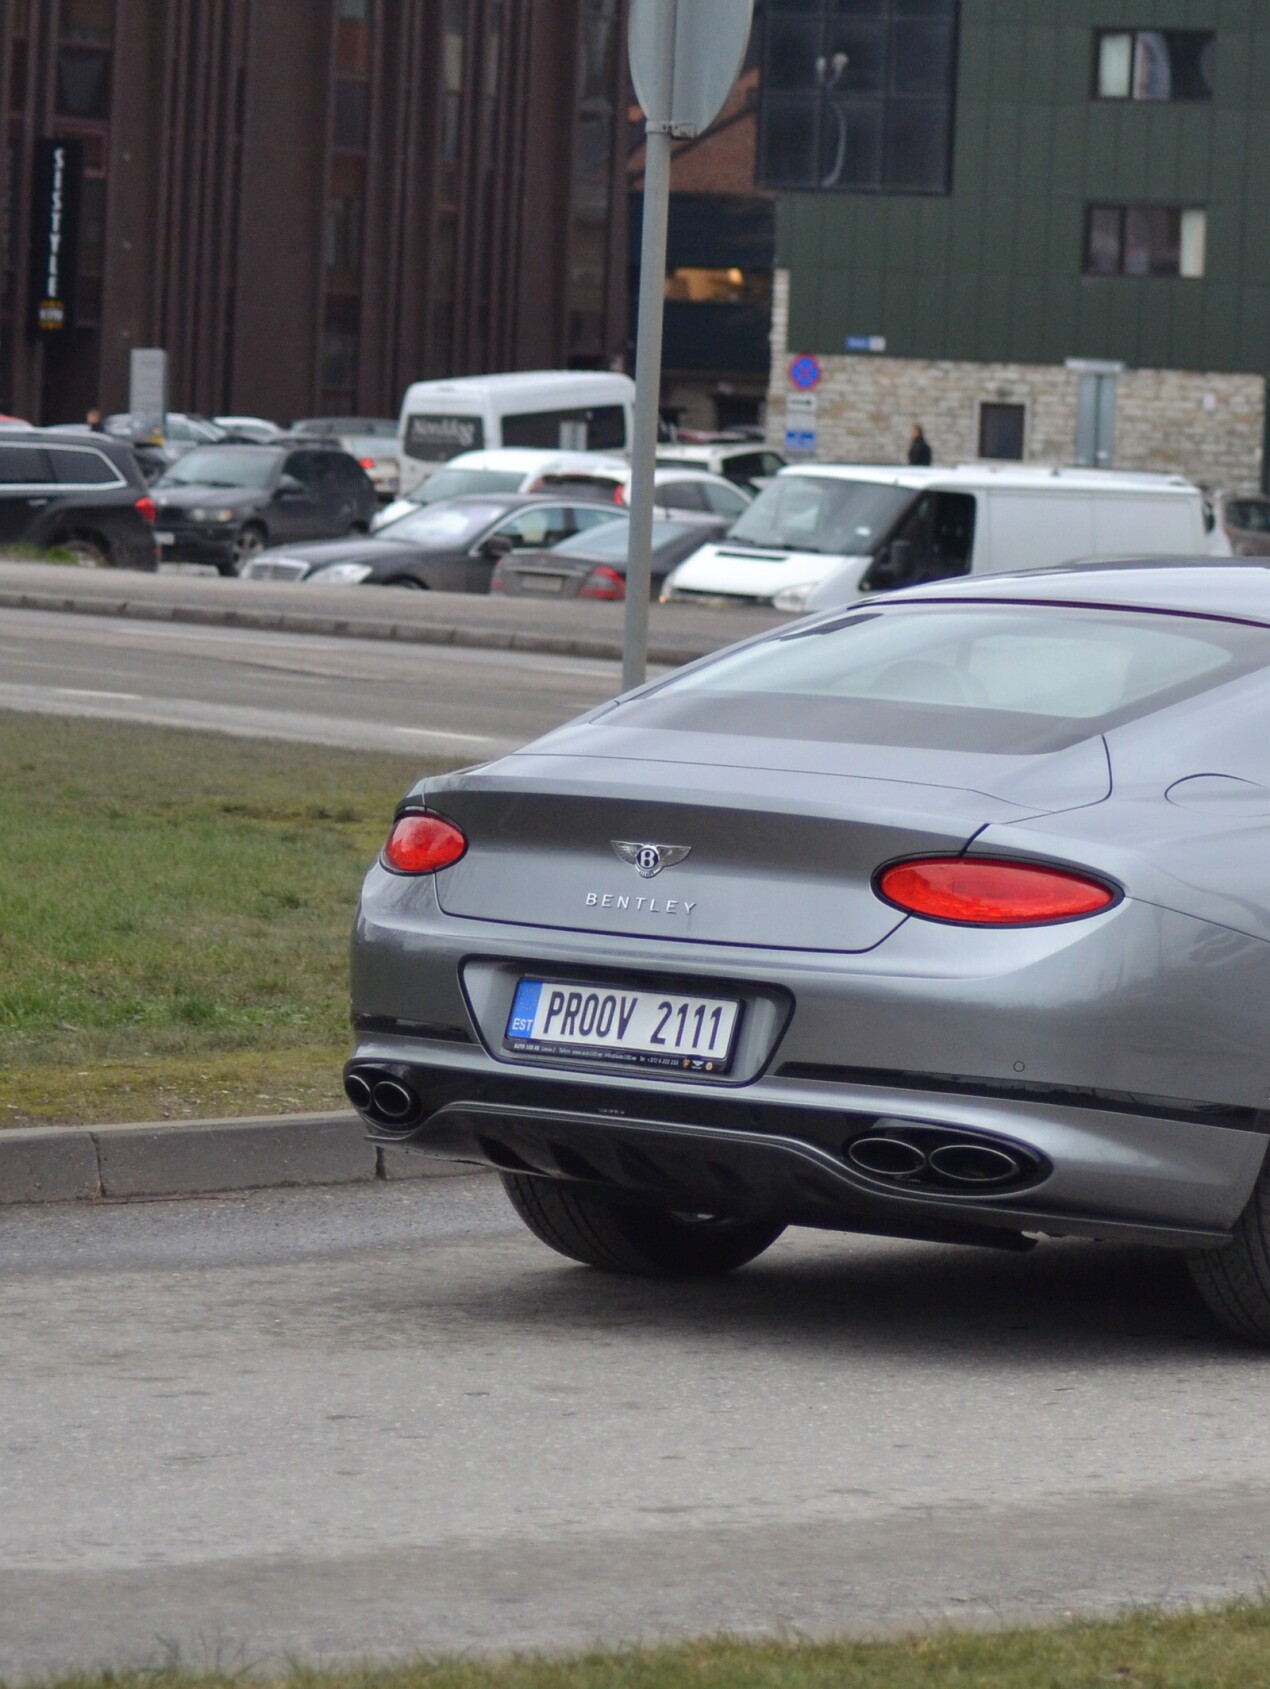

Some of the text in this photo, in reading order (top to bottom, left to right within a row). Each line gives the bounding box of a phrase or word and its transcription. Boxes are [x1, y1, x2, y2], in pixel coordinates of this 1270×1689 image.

[585, 893, 697, 914] BENTLEY
[511, 1017, 533, 1032] EST
[543, 990, 723, 1051] PROOV 2111
